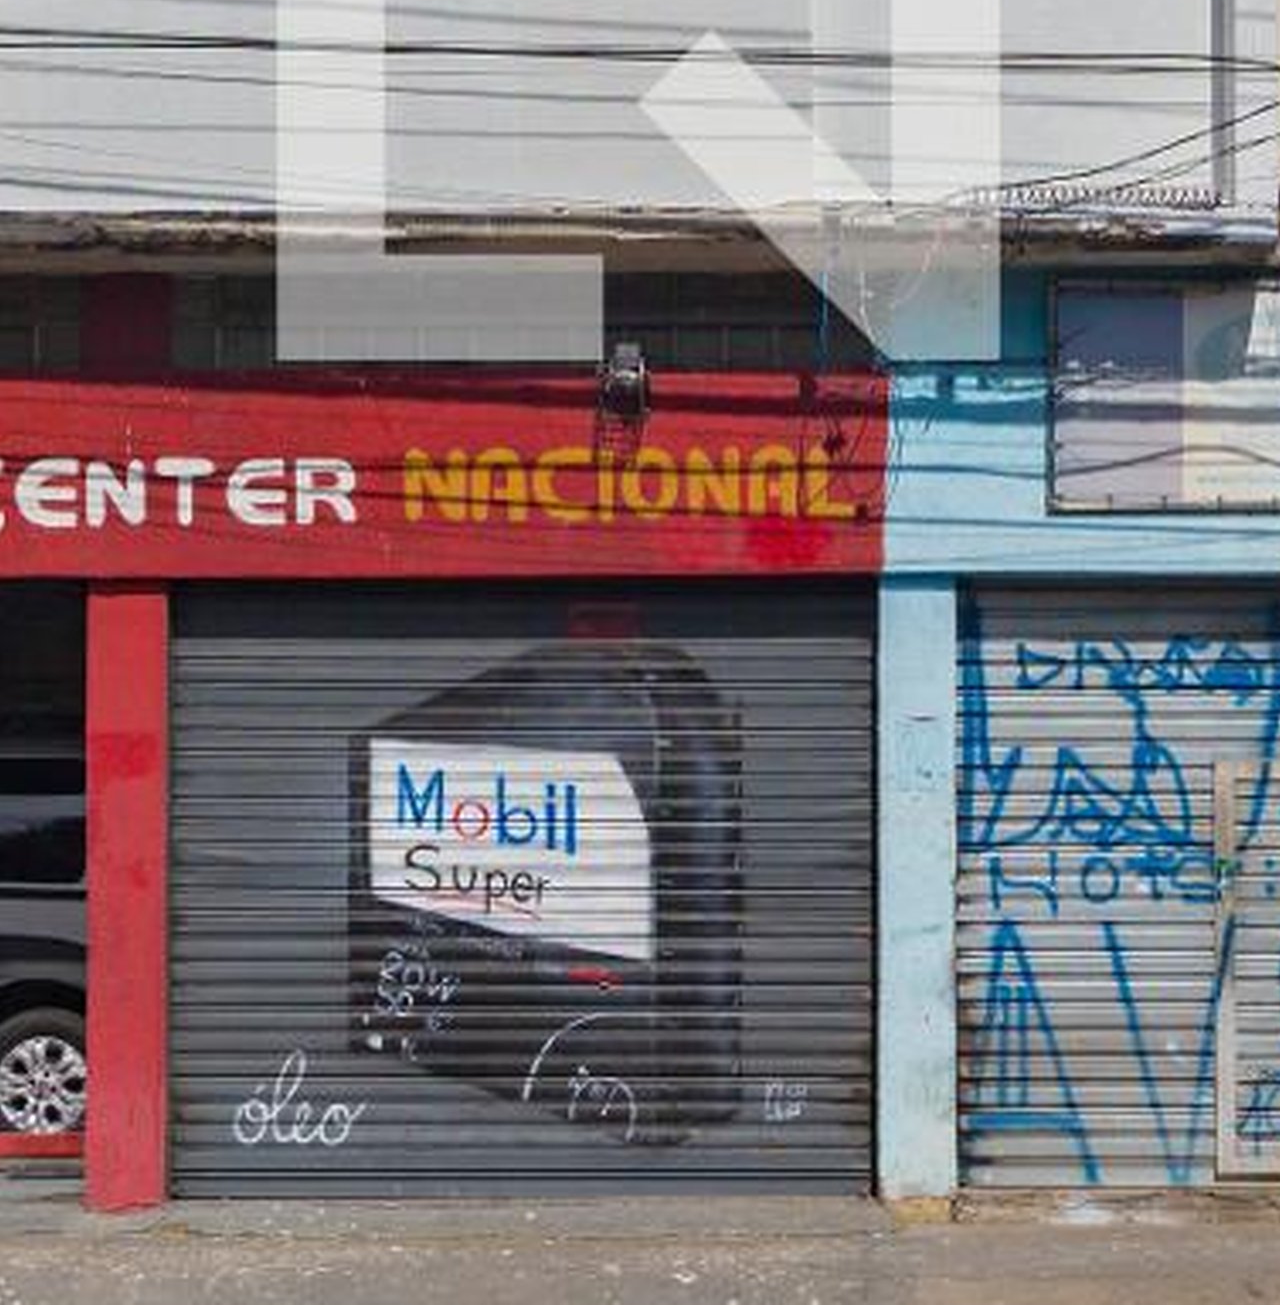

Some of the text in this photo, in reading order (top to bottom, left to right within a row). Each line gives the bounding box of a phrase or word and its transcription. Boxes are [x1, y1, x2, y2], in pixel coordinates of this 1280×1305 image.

[404, 444, 859, 524] NACIONAL
[397, 761, 579, 857] Mobil
[404, 844, 551, 915] Super
[232, 1049, 368, 1146] óleo
